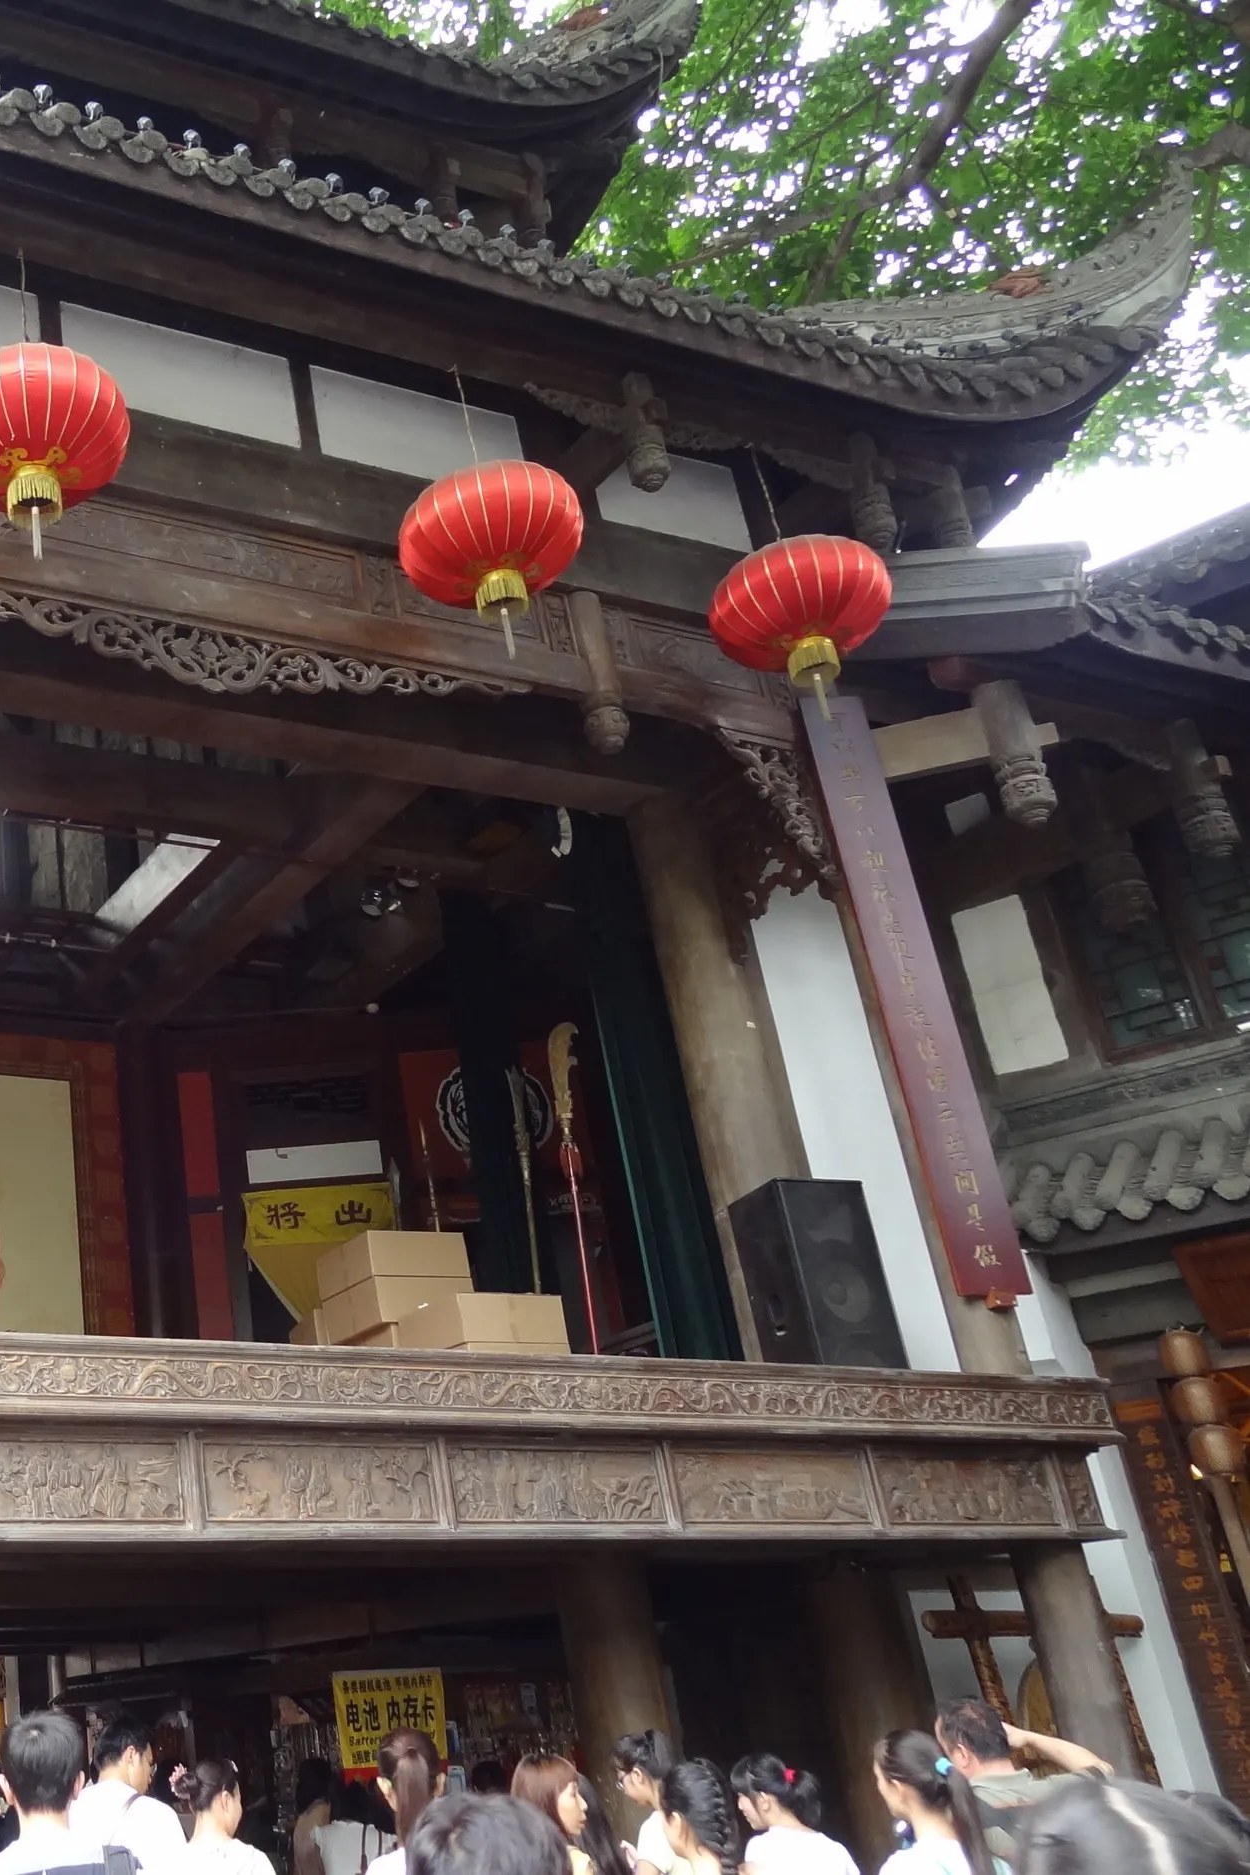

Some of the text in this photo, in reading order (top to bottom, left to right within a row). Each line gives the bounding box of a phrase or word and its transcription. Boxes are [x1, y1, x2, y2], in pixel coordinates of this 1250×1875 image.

[346, 1693, 436, 1733] 电池 内存卡
